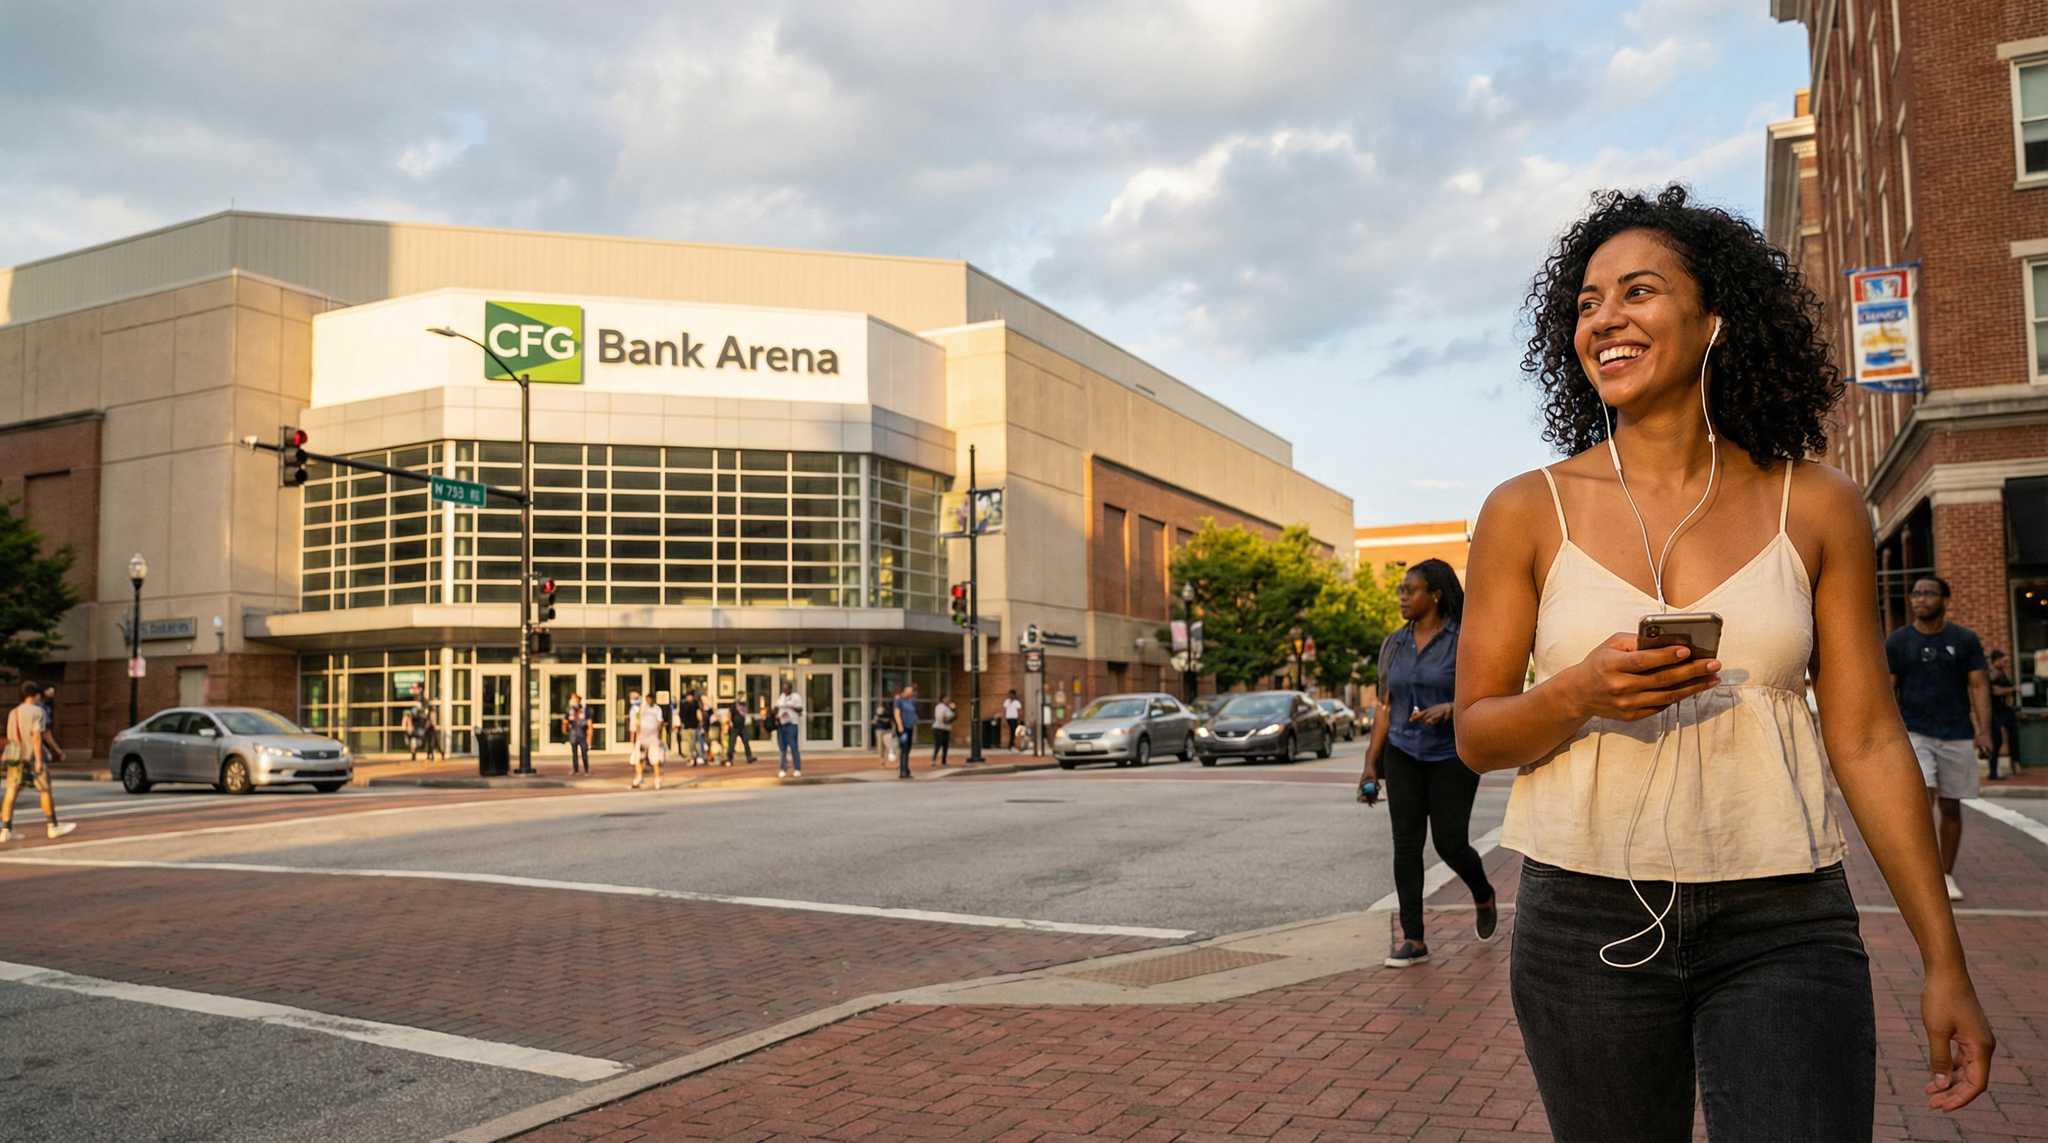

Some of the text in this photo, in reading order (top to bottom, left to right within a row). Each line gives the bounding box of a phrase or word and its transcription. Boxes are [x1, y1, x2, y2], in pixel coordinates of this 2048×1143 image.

[488, 323, 839, 375] CFG Bank Arena
